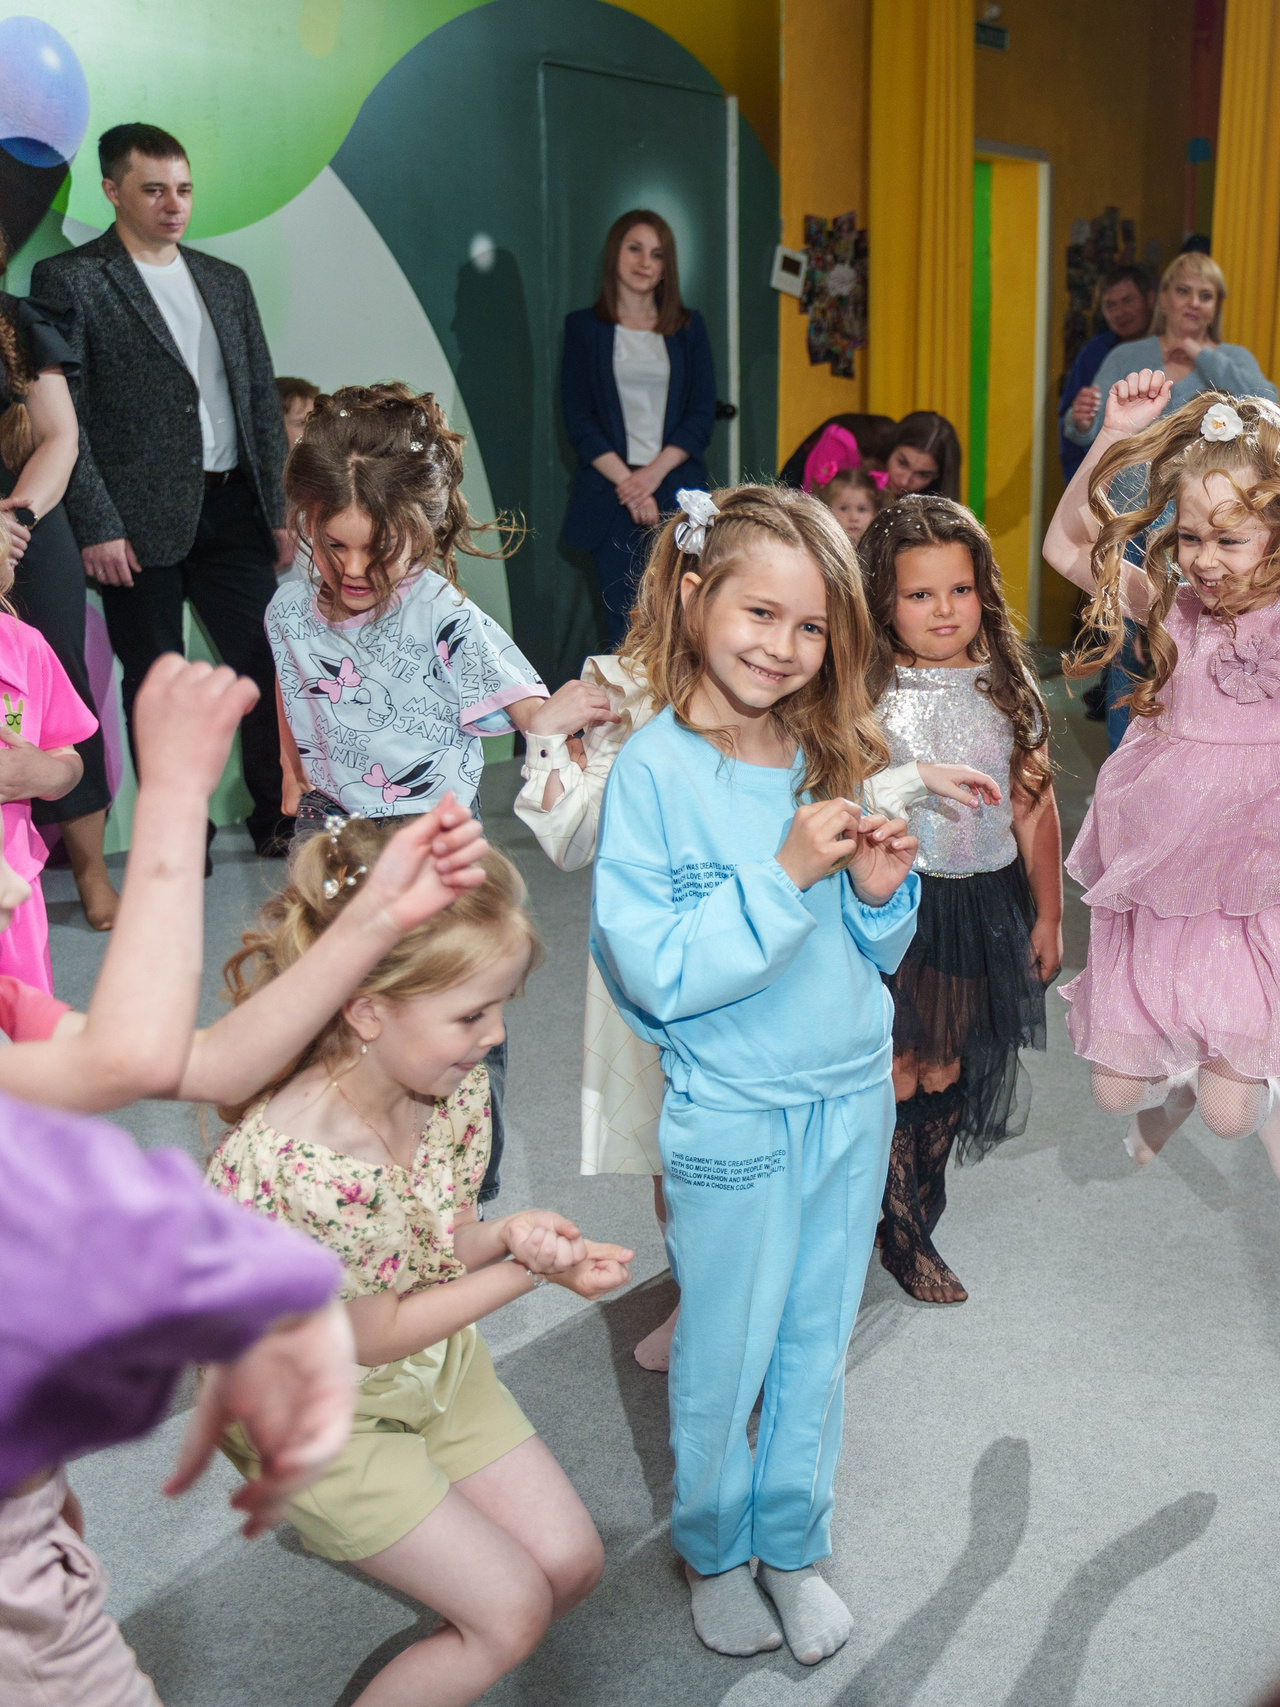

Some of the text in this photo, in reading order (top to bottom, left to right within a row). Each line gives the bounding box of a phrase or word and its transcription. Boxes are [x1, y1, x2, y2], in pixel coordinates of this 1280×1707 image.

[315, 715, 371, 751] MARC
[393, 716, 466, 749] JANIE
[672, 1151, 684, 1160] THIS
[685, 1156, 713, 1164] GARMENT
[671, 1160, 684, 1168] WITH
[744, 1164, 763, 1173] PEOPLE
[679, 1170, 702, 1179] FOLLOW
[704, 1174, 728, 1182] FASHION
